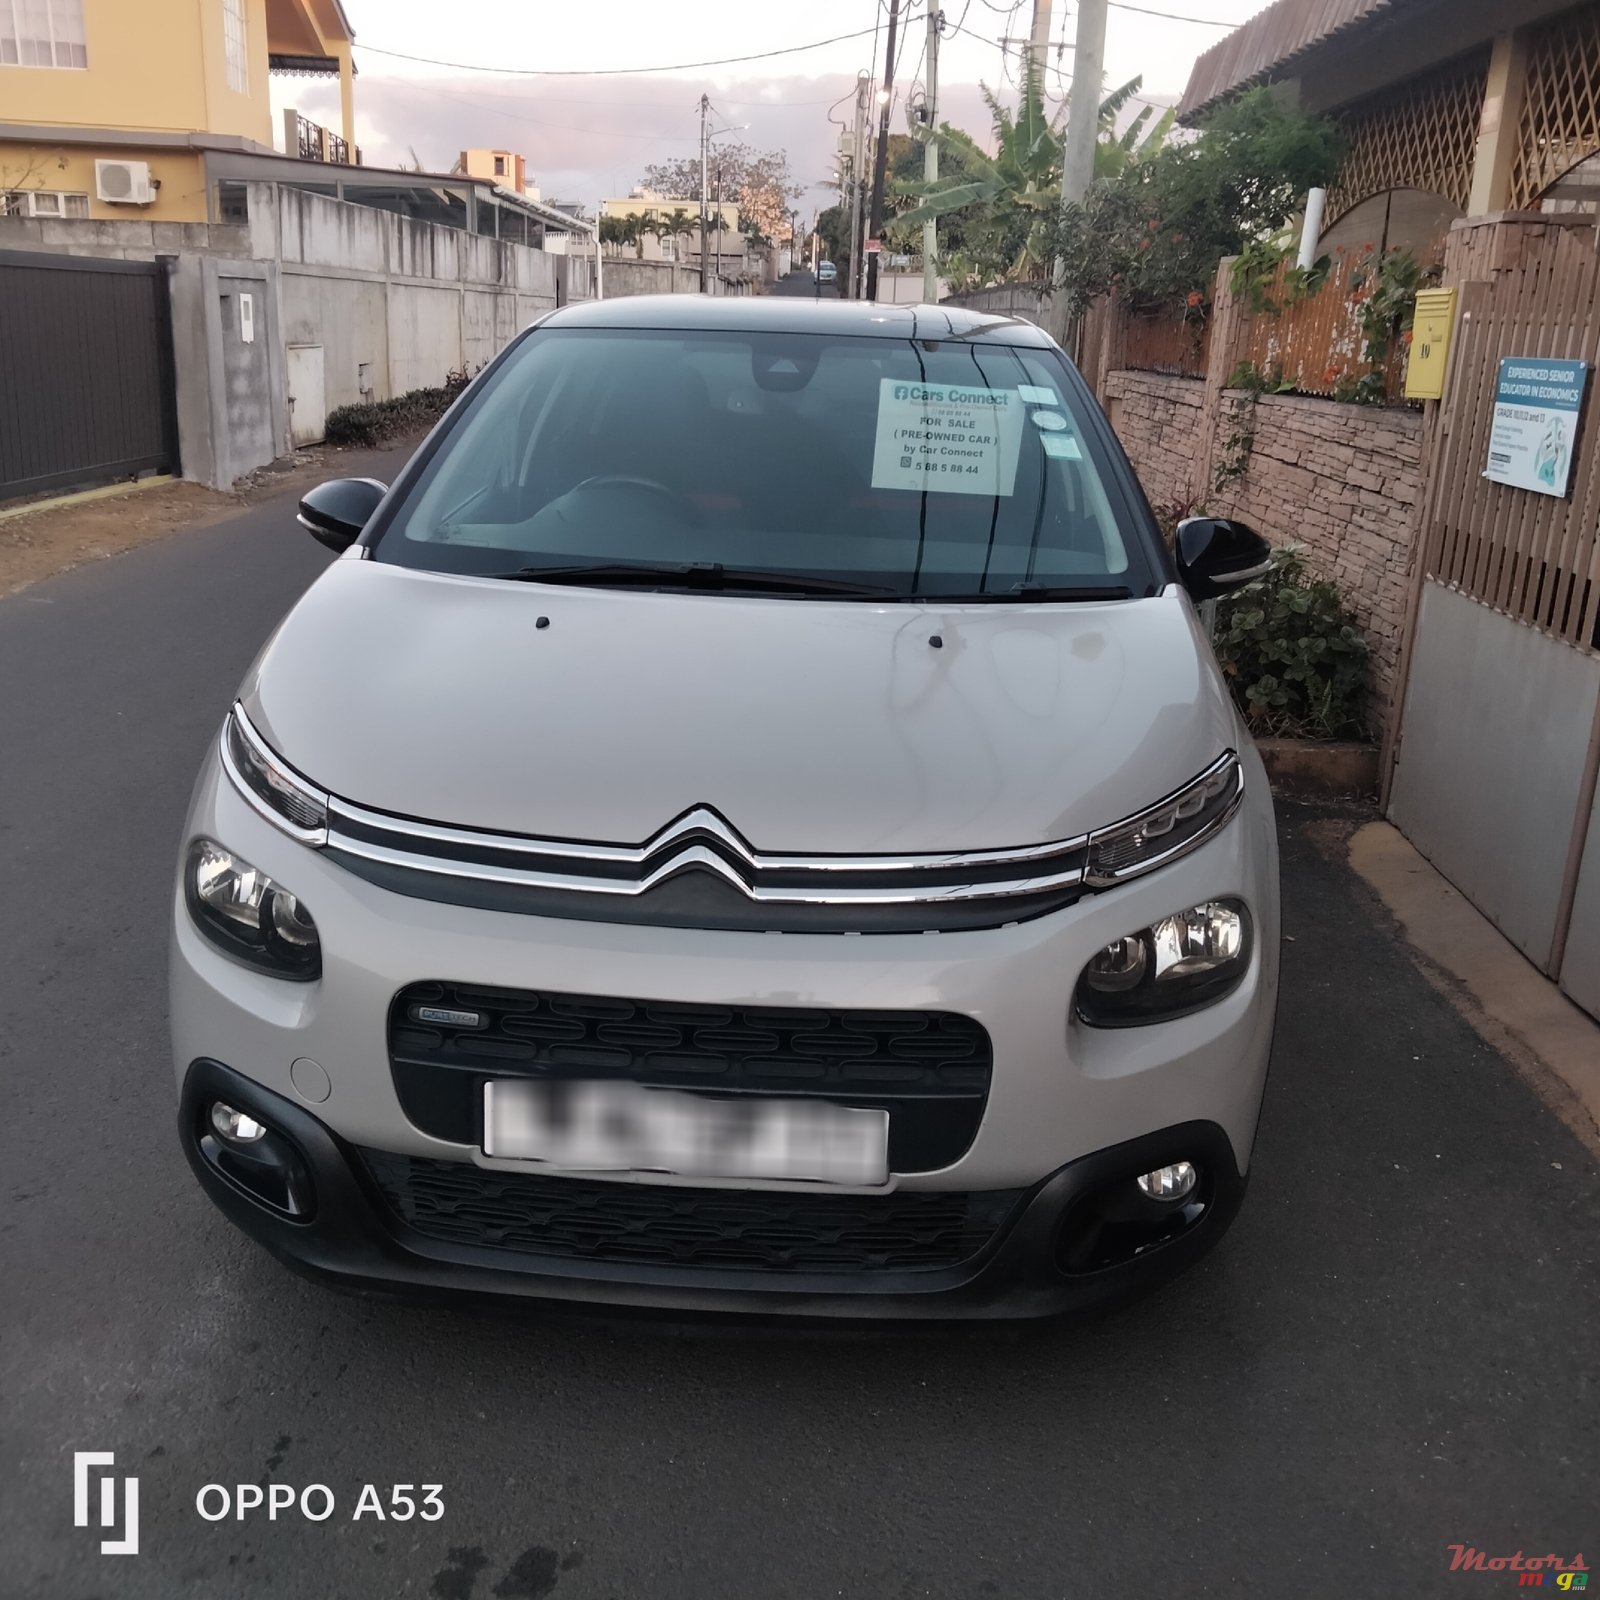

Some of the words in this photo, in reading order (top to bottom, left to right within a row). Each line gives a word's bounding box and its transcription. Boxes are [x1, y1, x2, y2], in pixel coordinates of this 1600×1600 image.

[1508, 366, 1548, 380] EXPERIENCED
[1549, 369, 1575, 383] SENIOR
[910, 387, 944, 402] Cars
[948, 389, 1008, 405] Connect
[1500, 382, 1531, 396] EDUCATOR
[1531, 385, 1538, 397] IN
[1539, 386, 1579, 402] ECONOMICS
[1497, 408, 1512, 418] GRADE
[1529, 413, 1539, 422] and
[920, 416, 942, 426] FOR
[948, 418, 976, 429] SALE
[901, 429, 965, 442] PRE-OWNED
[968, 435, 991, 444] CAR
[904, 444, 915, 454] by
[920, 445, 938, 454] Car
[941, 446, 983, 458] Connect
[965, 466, 979, 474] 44
